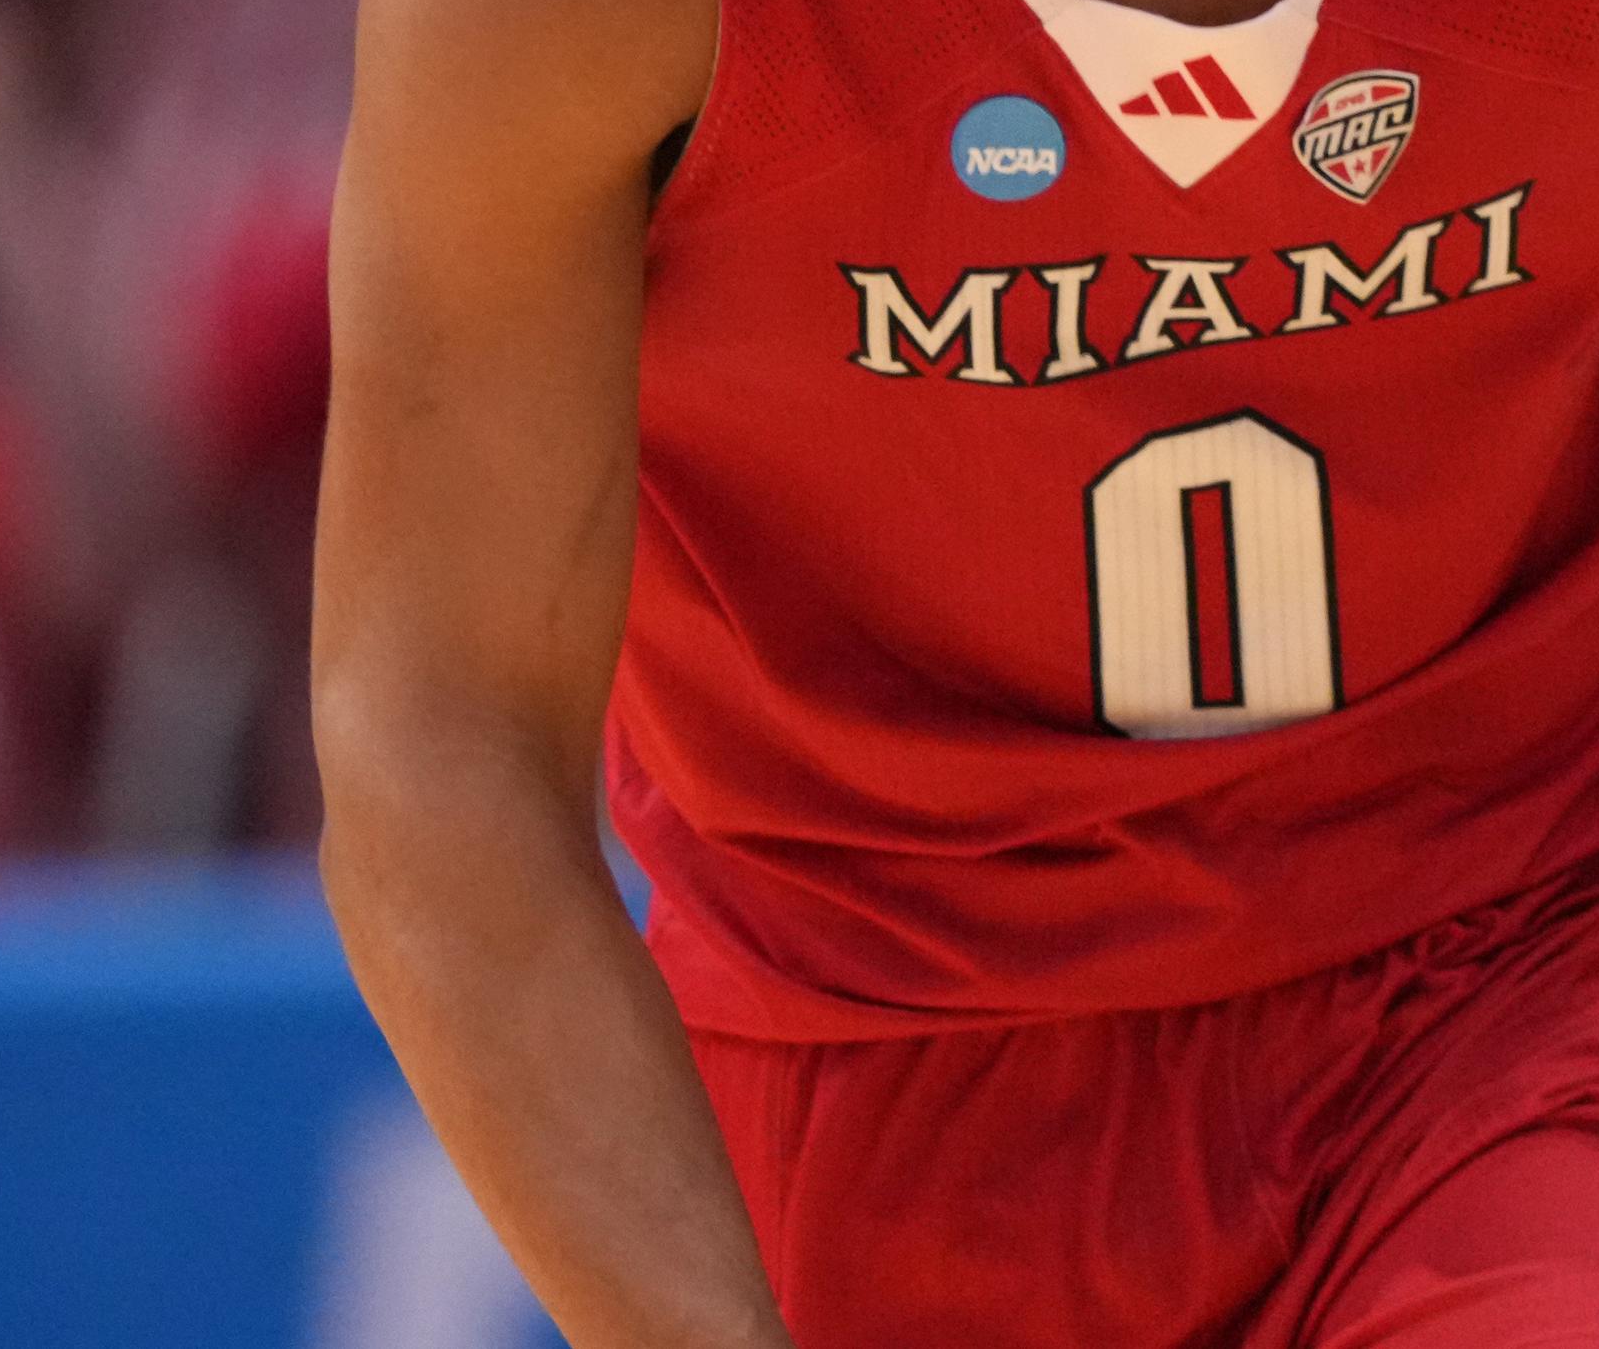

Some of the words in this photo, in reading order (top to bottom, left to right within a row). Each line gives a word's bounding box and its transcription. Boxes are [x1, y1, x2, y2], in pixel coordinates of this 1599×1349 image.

[965, 146, 1058, 176] NCAA
[1303, 103, 1411, 164] MAC
[836, 180, 1535, 387] MIAMI
[1084, 406, 1346, 741] 0
